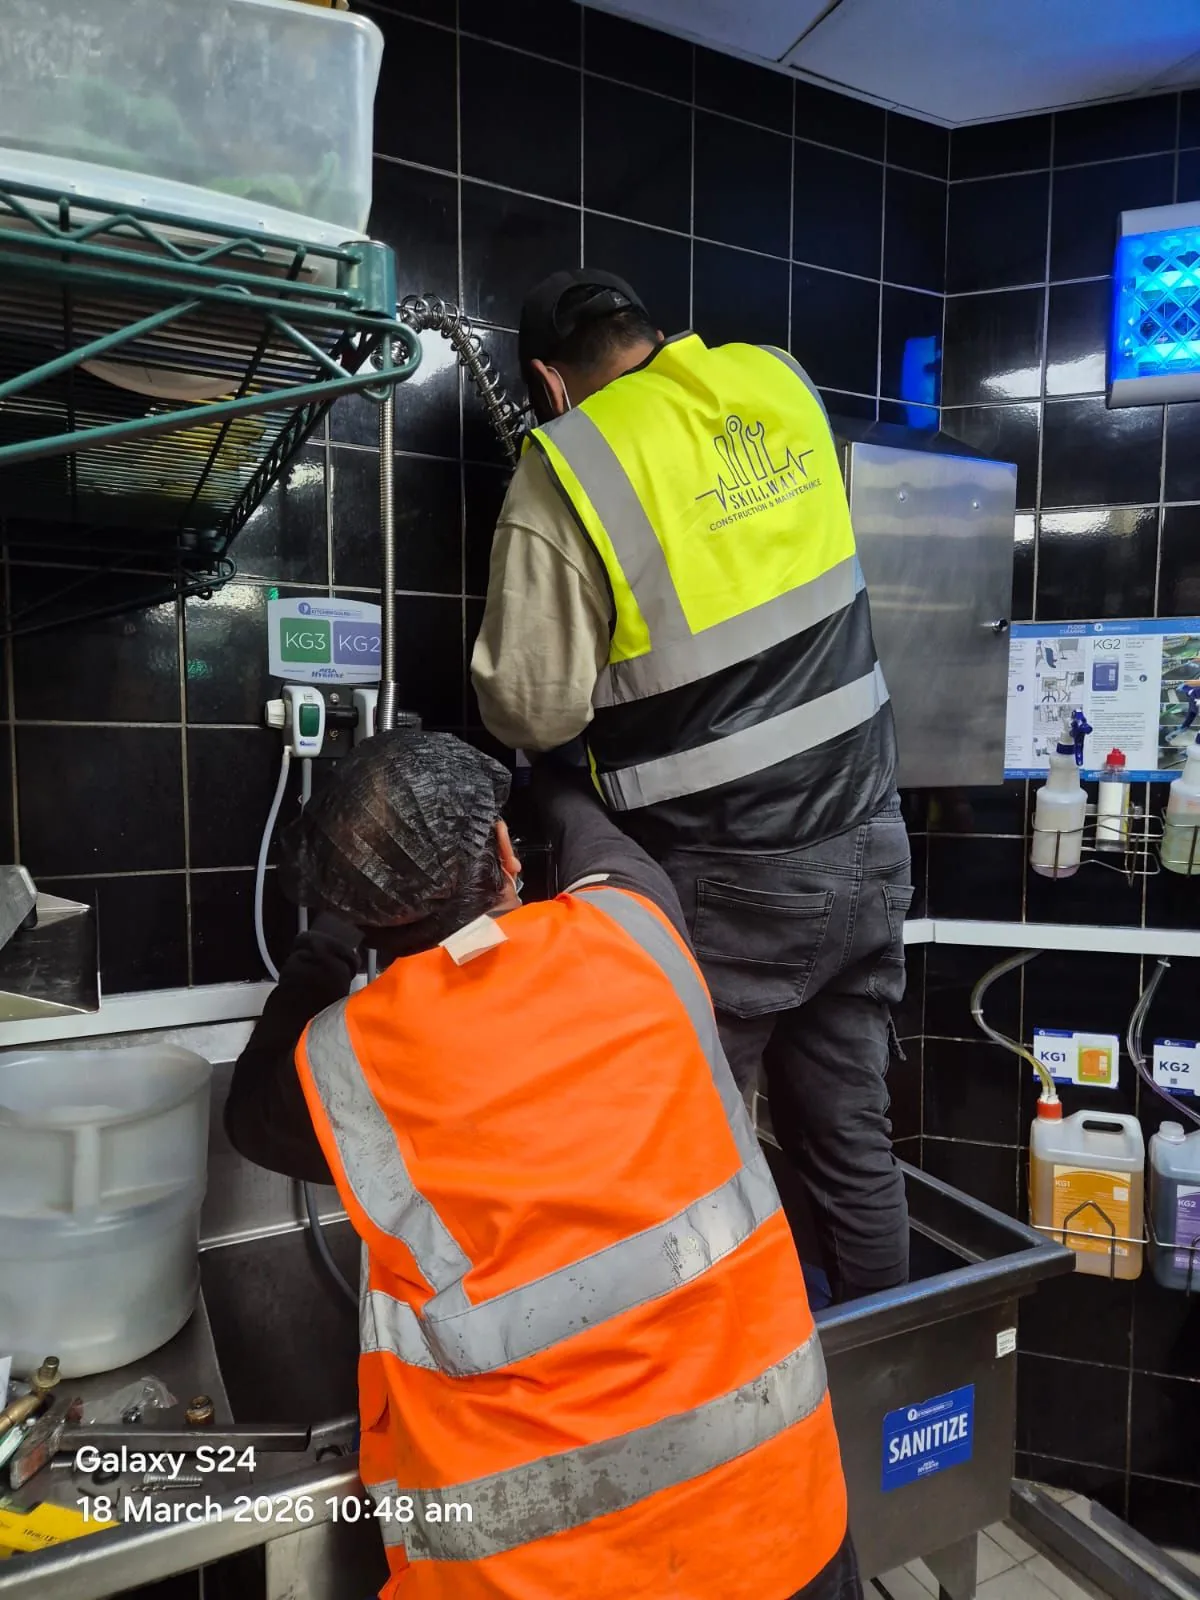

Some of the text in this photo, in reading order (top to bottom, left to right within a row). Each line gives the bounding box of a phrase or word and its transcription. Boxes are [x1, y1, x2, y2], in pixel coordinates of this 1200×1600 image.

[729, 470, 799, 510] SKILLWAY
[709, 503, 768, 531] CONSTRUCTION
[285, 631, 381, 653] KG3 KG2
[1092, 638, 1121, 651] KG2
[1039, 1051, 1067, 1063] KG1
[1158, 1060, 1191, 1074] KG2
[1055, 1179, 1071, 1188] KG1
[1177, 1199, 1197, 1208] KG2
[888, 1412, 969, 1464] SANITIZE
